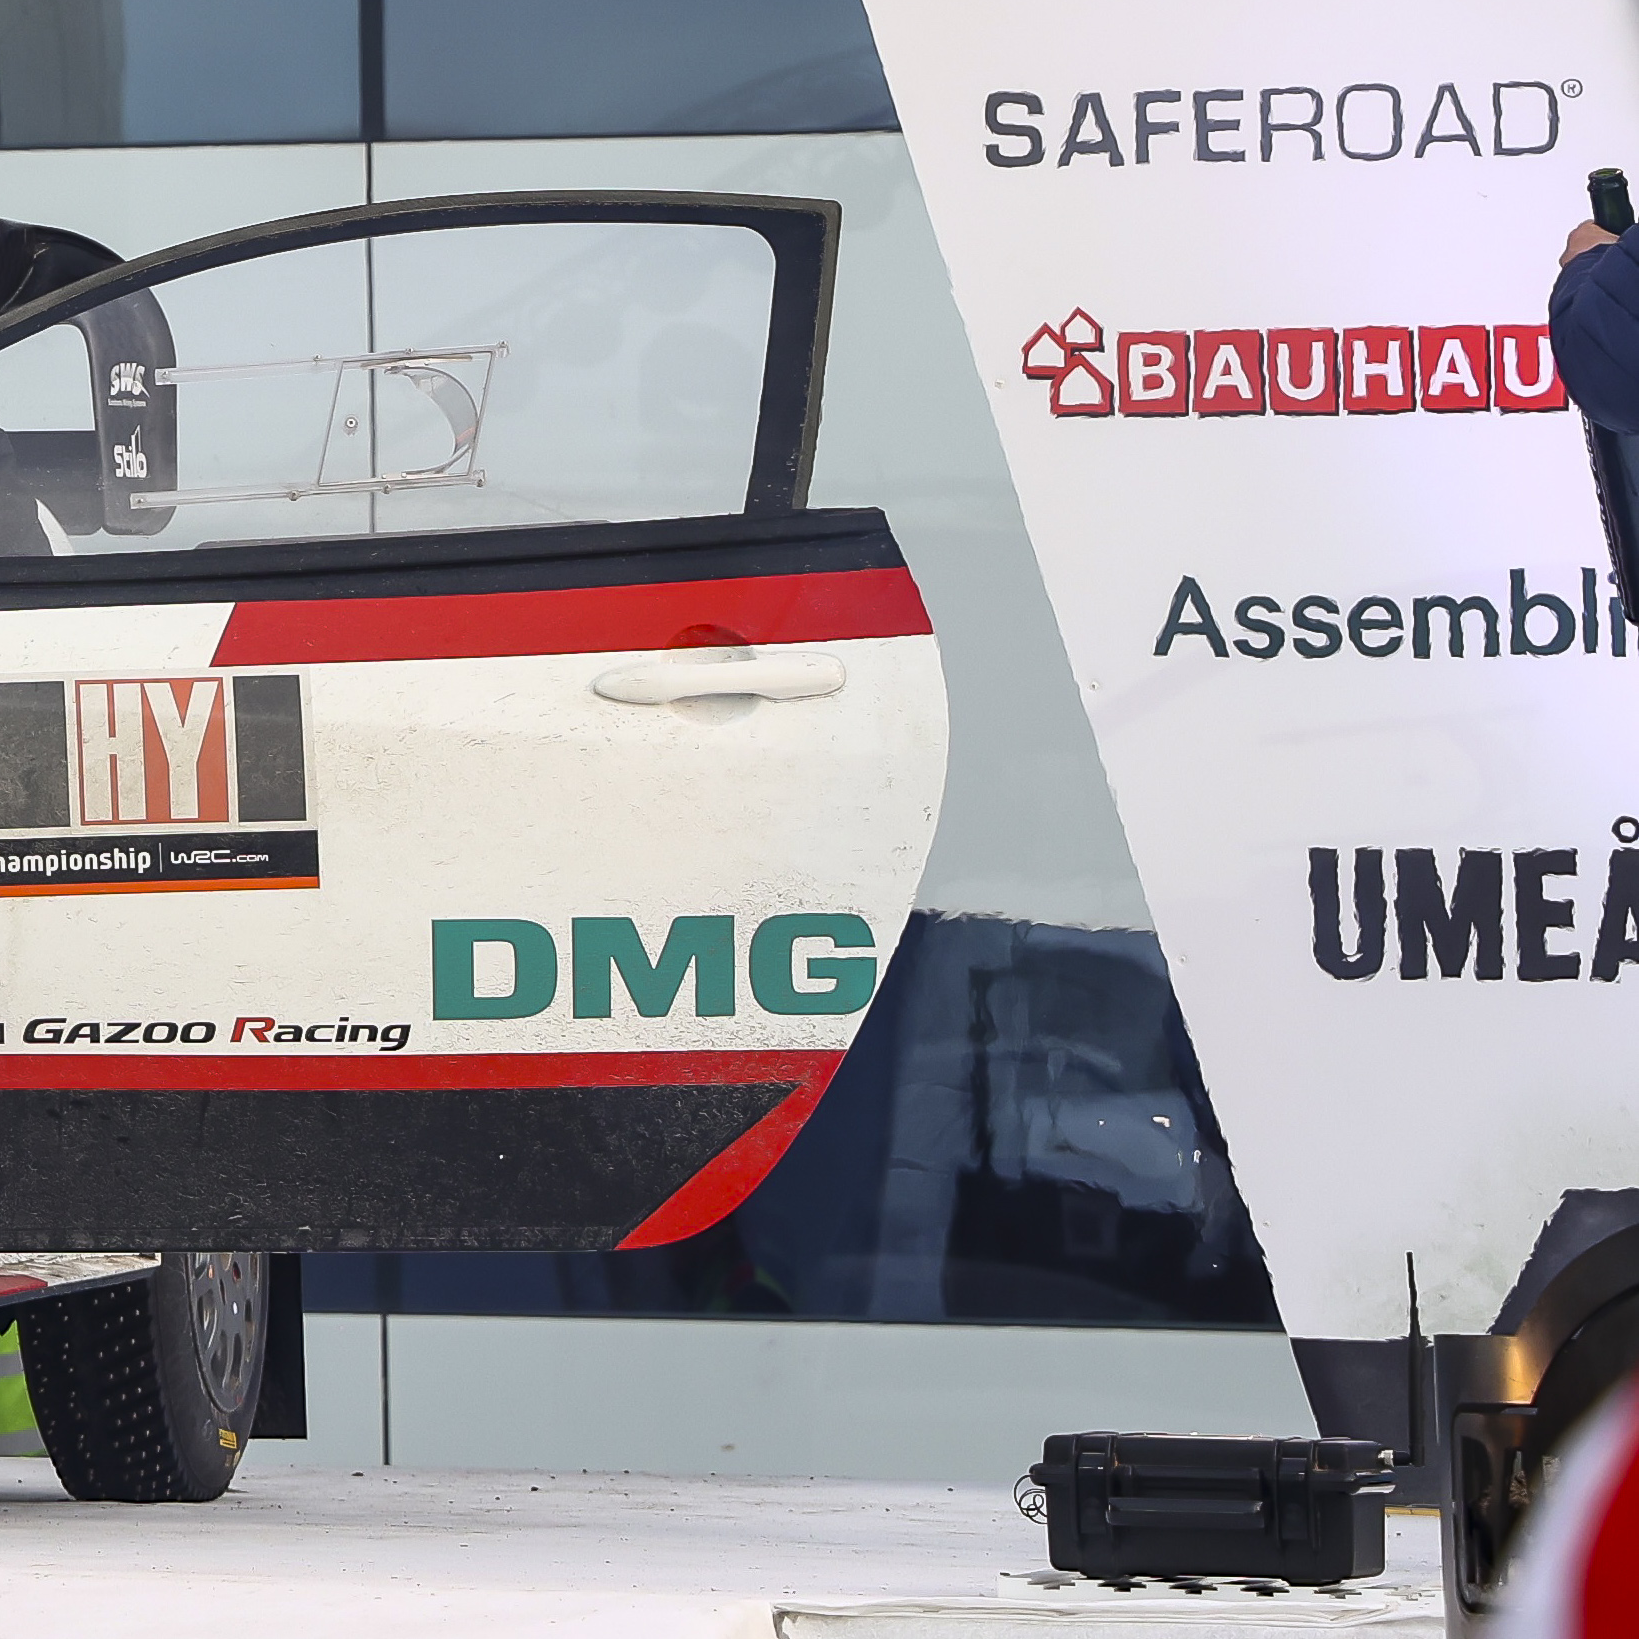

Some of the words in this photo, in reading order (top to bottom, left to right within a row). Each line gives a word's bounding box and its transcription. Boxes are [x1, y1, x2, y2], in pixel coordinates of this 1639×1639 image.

[1126, 336, 1562, 402] BAUHAU
[113, 424, 148, 479] Stilo
[1152, 567, 1639, 660] Assembli
[78, 679, 220, 822] HY
[431, 912, 878, 1021] DMG
[22, 1017, 217, 1045] GAZOO
[229, 1015, 412, 1051] Racing
